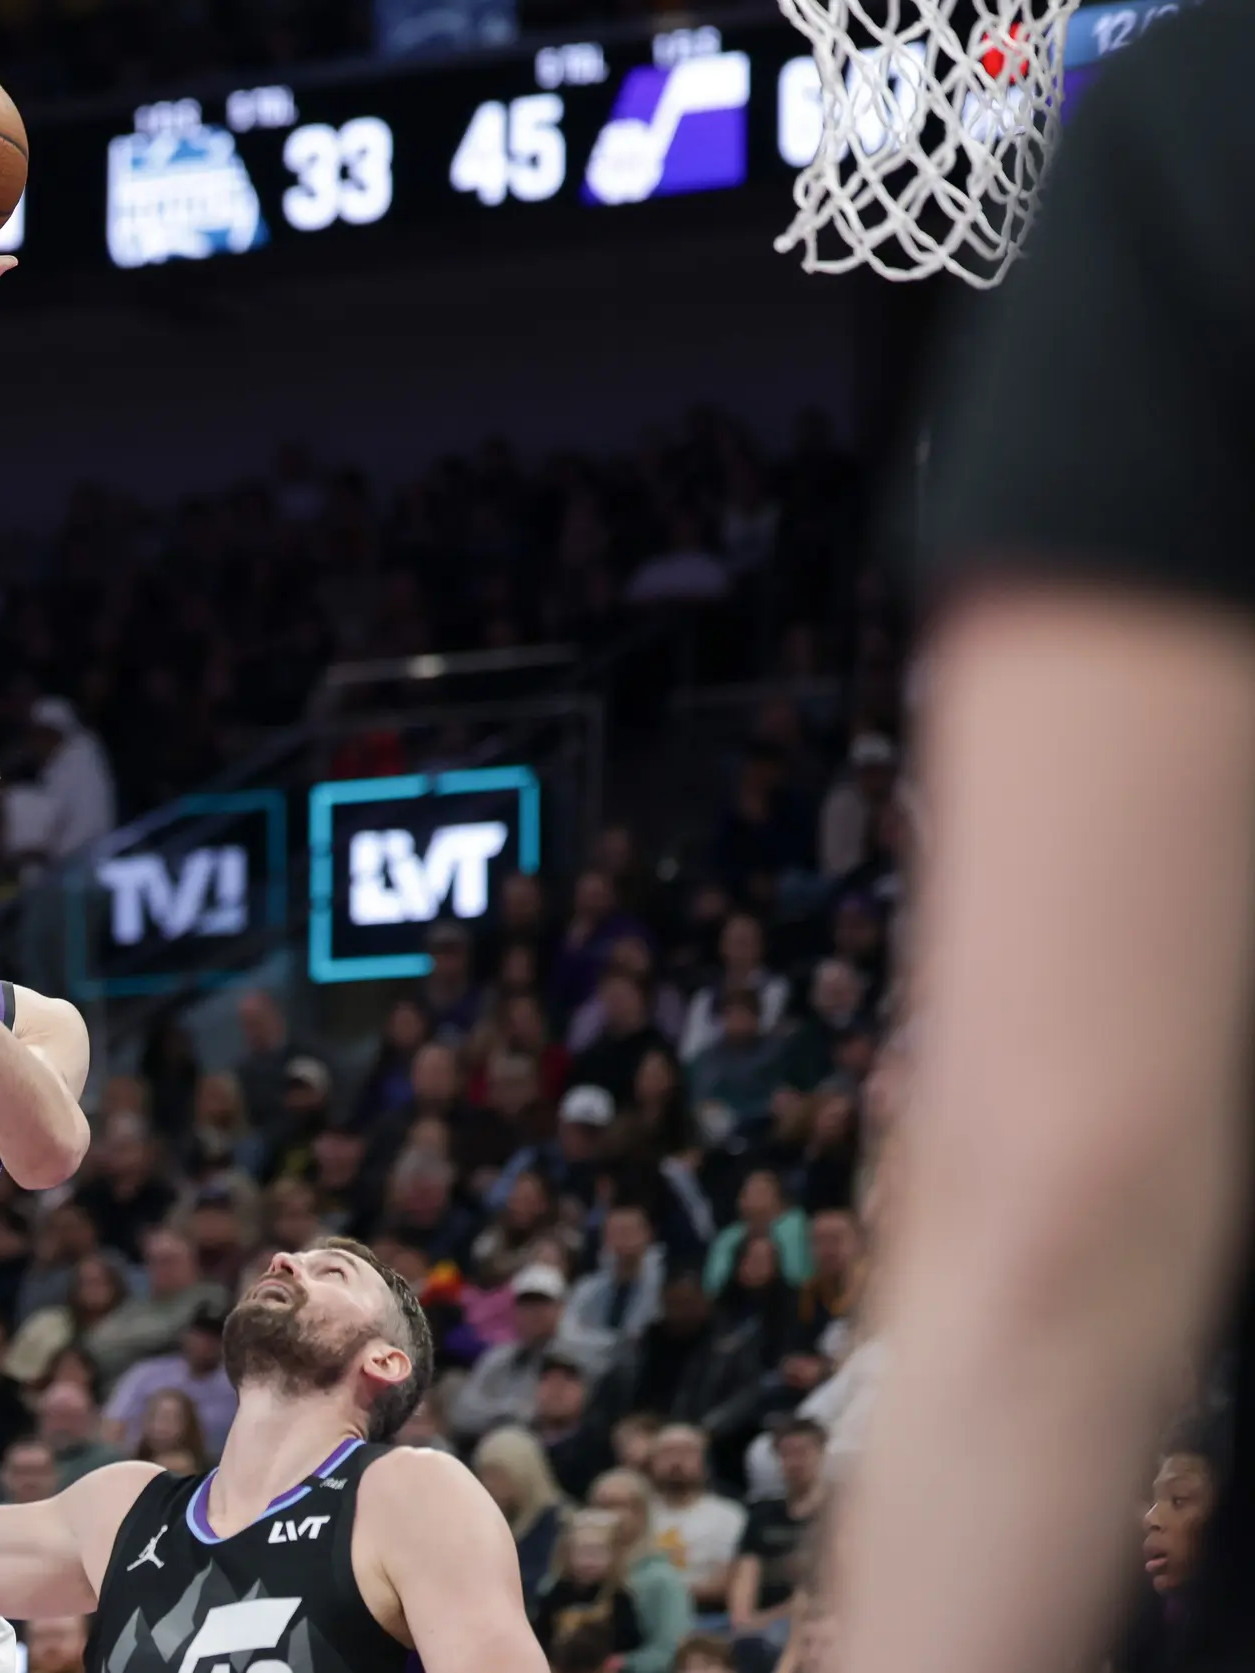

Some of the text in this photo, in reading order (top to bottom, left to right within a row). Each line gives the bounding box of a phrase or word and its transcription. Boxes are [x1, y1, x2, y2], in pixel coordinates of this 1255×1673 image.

[282, 116, 393, 231] 33
[449, 93, 566, 206] 45
[268, 1515, 331, 1544] LVT
